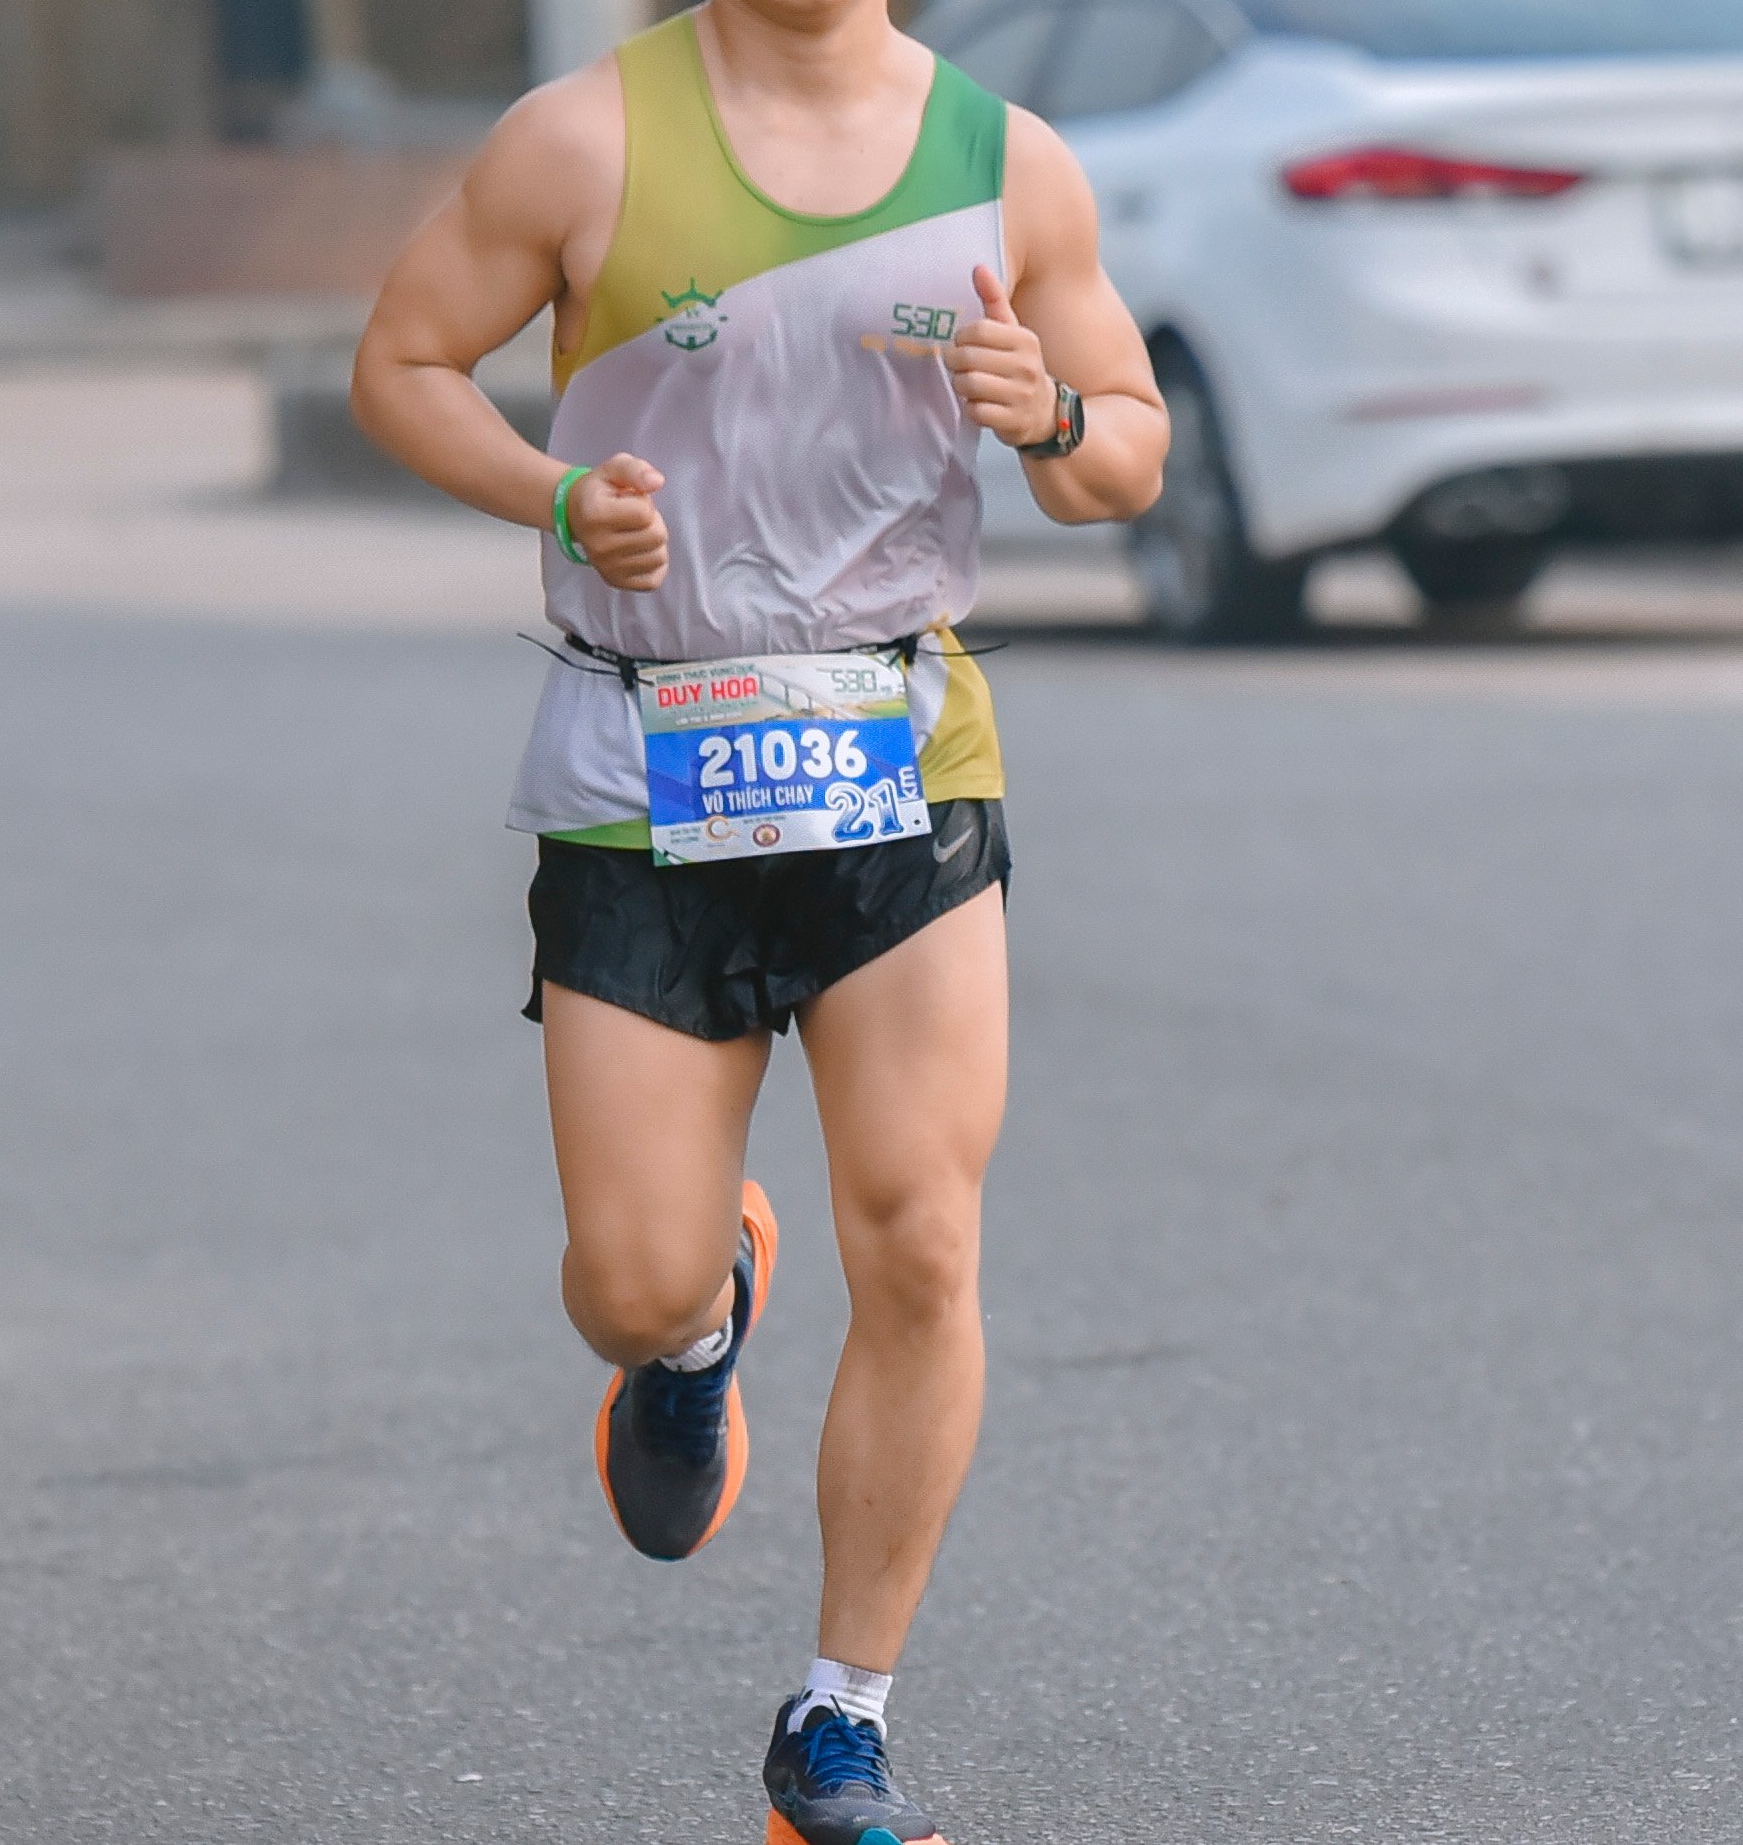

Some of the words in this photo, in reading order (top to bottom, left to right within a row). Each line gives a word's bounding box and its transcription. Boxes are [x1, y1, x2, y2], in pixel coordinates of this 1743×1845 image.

[657, 684, 703, 709] DUY
[698, 729, 868, 789] 21036
[726, 785, 772, 812] THÍCH
[825, 778, 904, 843] 21
